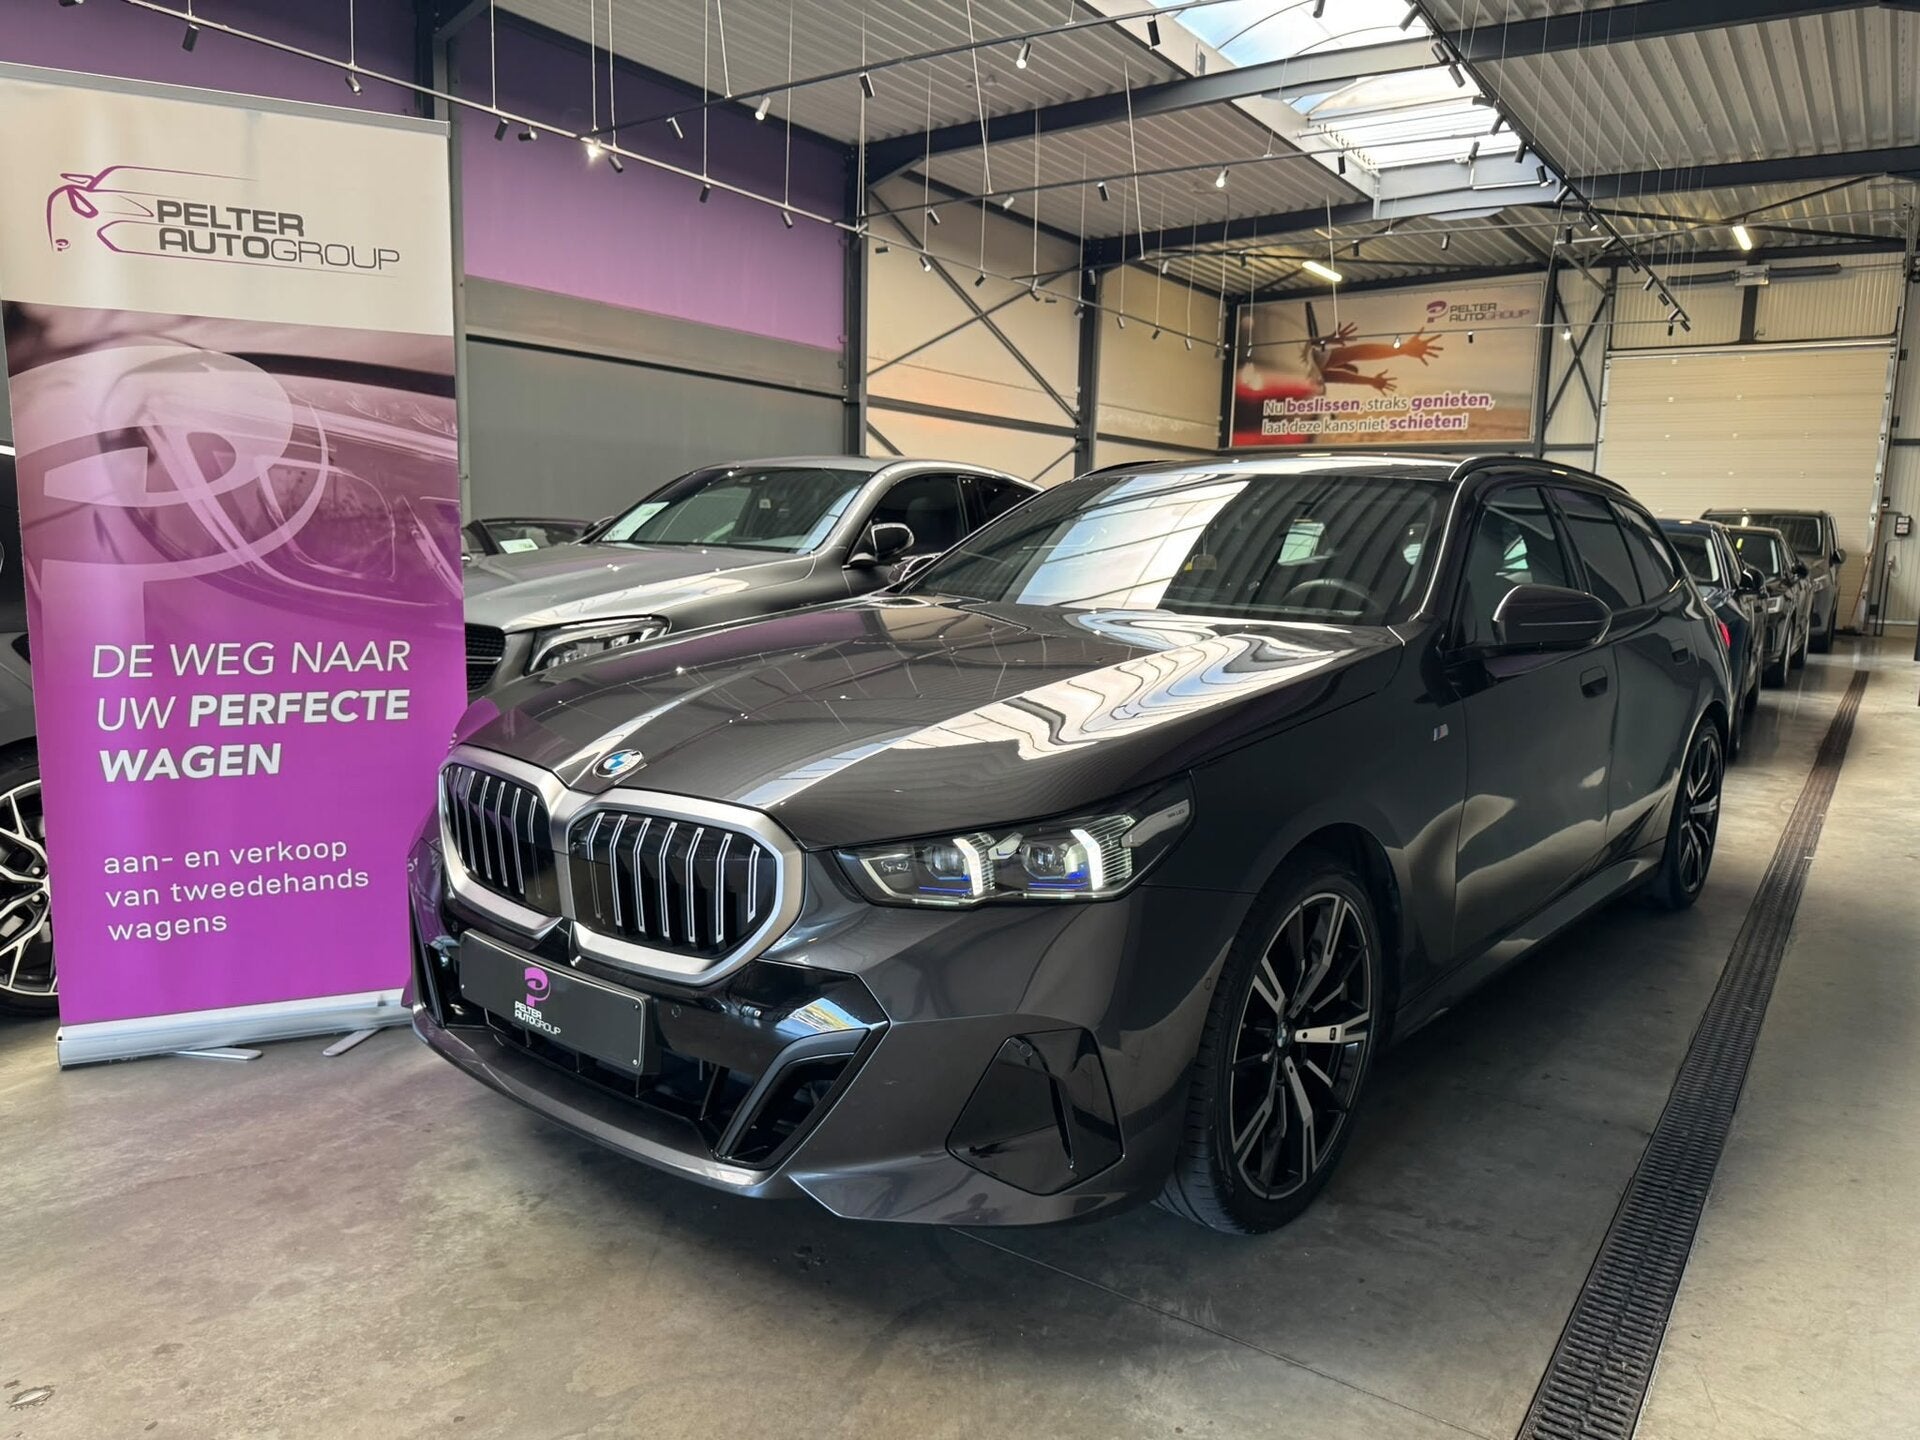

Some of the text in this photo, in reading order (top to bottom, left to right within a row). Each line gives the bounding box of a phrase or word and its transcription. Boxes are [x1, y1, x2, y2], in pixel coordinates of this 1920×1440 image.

[156, 199, 304, 237] PELTER
[159, 227, 400, 270] AUTOGROUP
[1449, 309, 1530, 322] AUTOGROUP
[1450, 303, 1497, 313] PELTER
[1264, 393, 1494, 415] Nu beslissen, straks genieten,
[1263, 415, 1468, 434] laat deze kans niet schieten!
[92, 640, 411, 678] DE WEG NAAR
[98, 689, 411, 731] UW PERFECTE
[100, 743, 282, 783] WAGEN
[104, 841, 347, 874] aan- en verkoop
[105, 868, 370, 908] van tweedehands
[108, 914, 228, 941] wagens
[515, 1000, 542, 1020] PELTER
[515, 1009, 561, 1035] AUTOGROUP
